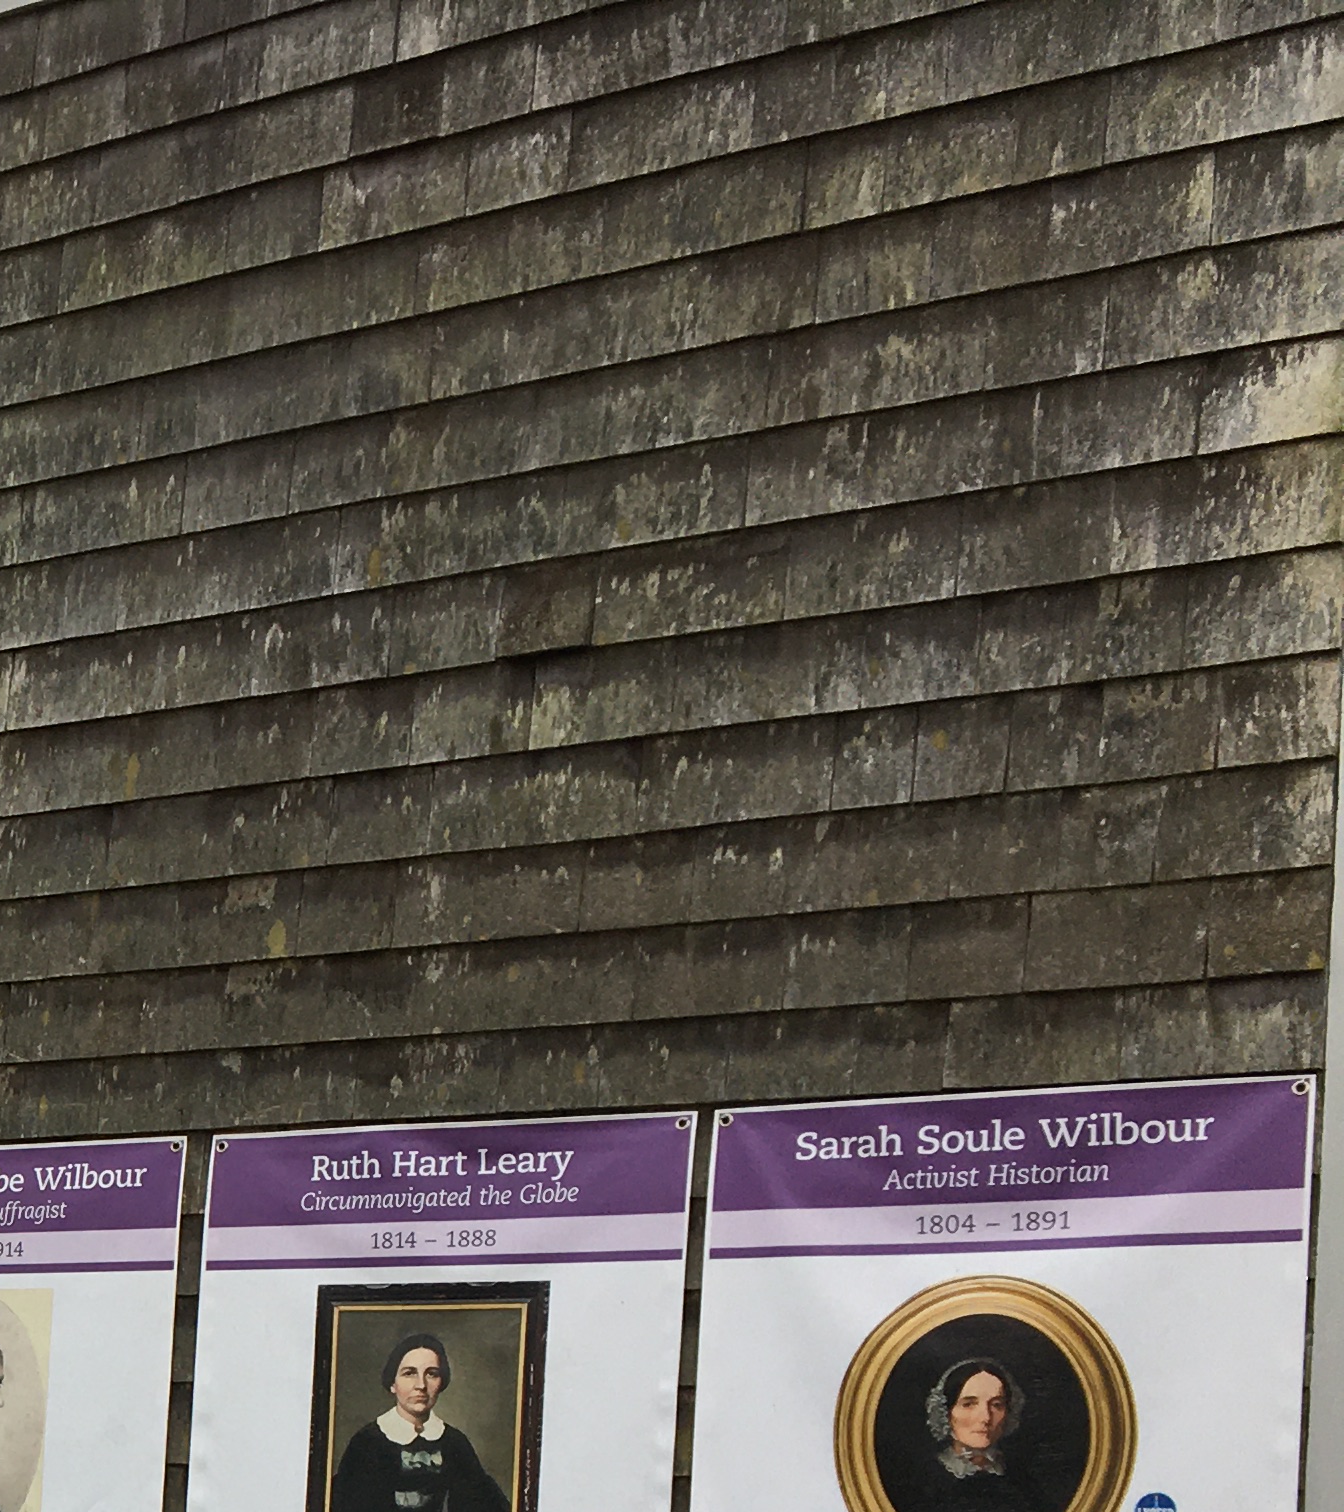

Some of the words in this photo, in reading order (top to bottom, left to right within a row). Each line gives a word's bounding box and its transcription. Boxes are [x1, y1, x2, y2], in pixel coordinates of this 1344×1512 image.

[795, 1124, 903, 1160] Sarah
[916, 1118, 1025, 1154] Soule
[1038, 1113, 1214, 1148] Wilbour
[33, 1163, 147, 1190] Wilbour
[310, 1150, 381, 1181] Ruth
[391, 1150, 467, 1177] Hart
[477, 1148, 574, 1180] Leary
[882, 1164, 979, 1190] Activist
[986, 1163, 1108, 1185] Historian
[300, 1185, 471, 1213] Circumnavigated
[479, 1184, 512, 1205] the
[519, 1181, 579, 1204] Globe
[915, 1213, 976, 1234] 1804
[1011, 1210, 1070, 1231] 1891
[370, 1231, 417, 1249] 1814
[446, 1228, 496, 1247] 1888
